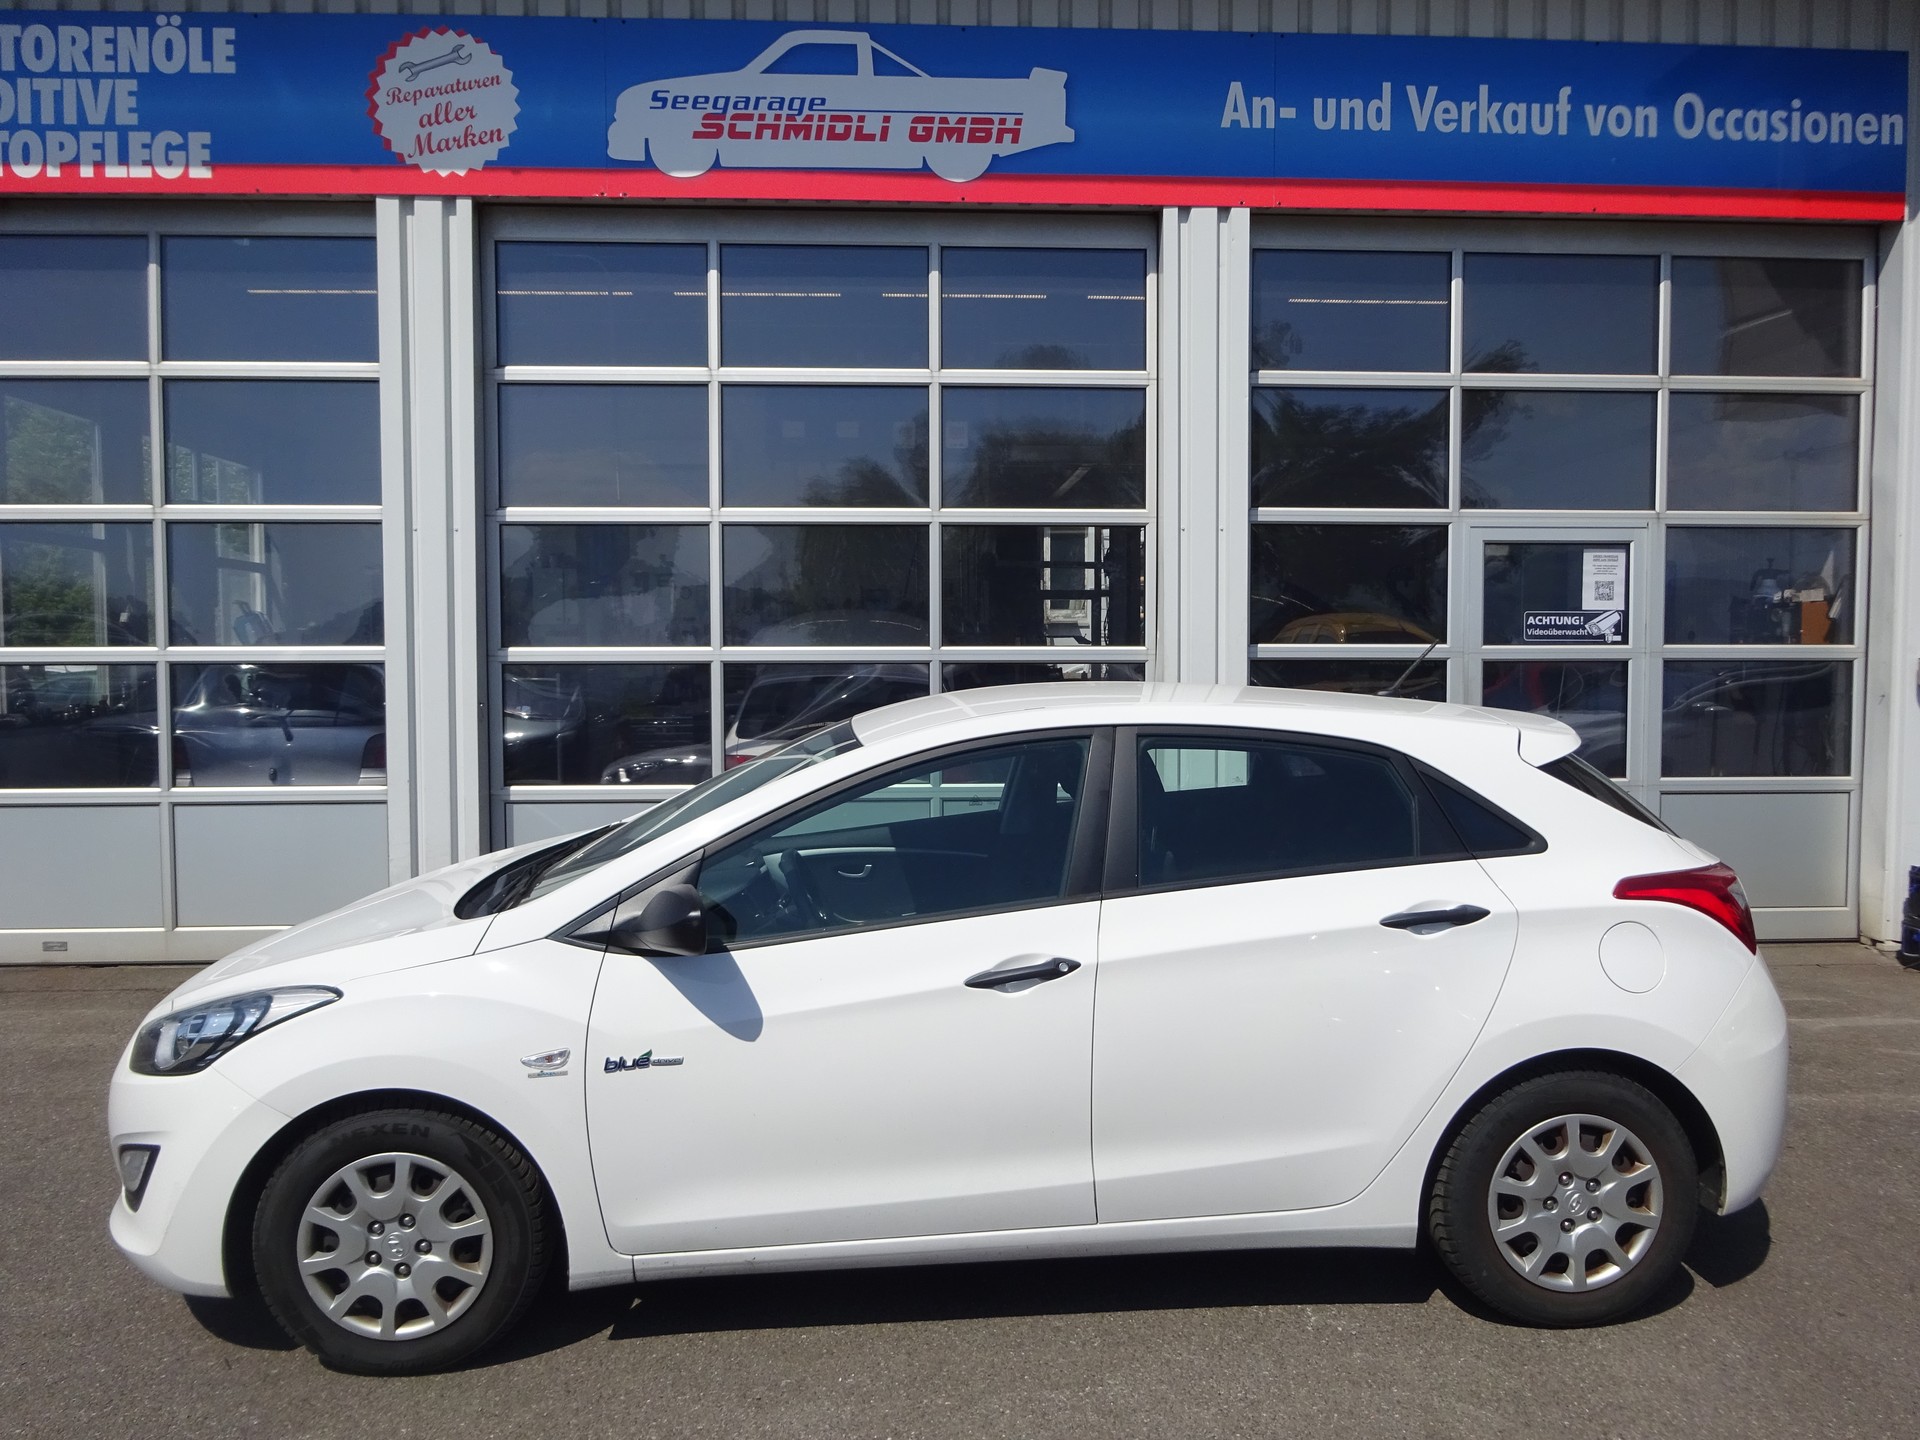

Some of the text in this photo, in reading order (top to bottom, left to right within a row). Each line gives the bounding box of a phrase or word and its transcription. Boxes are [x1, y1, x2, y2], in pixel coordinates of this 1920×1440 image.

[0, 14, 236, 74] TORENÖLE
[386, 74, 502, 106] Reparaturen
[649, 90, 826, 115] Seegarage
[418, 103, 478, 128] aller
[1220, 81, 1904, 146] An- und Verkauf von Occasionen
[692, 112, 1023, 144] SCHMIDLI GMBH
[407, 127, 506, 159] Marken
[1526, 615, 1584, 625] ACHTUNG!
[1526, 628, 1588, 636] Videoüberwacht
[603, 1056, 651, 1073] blue
